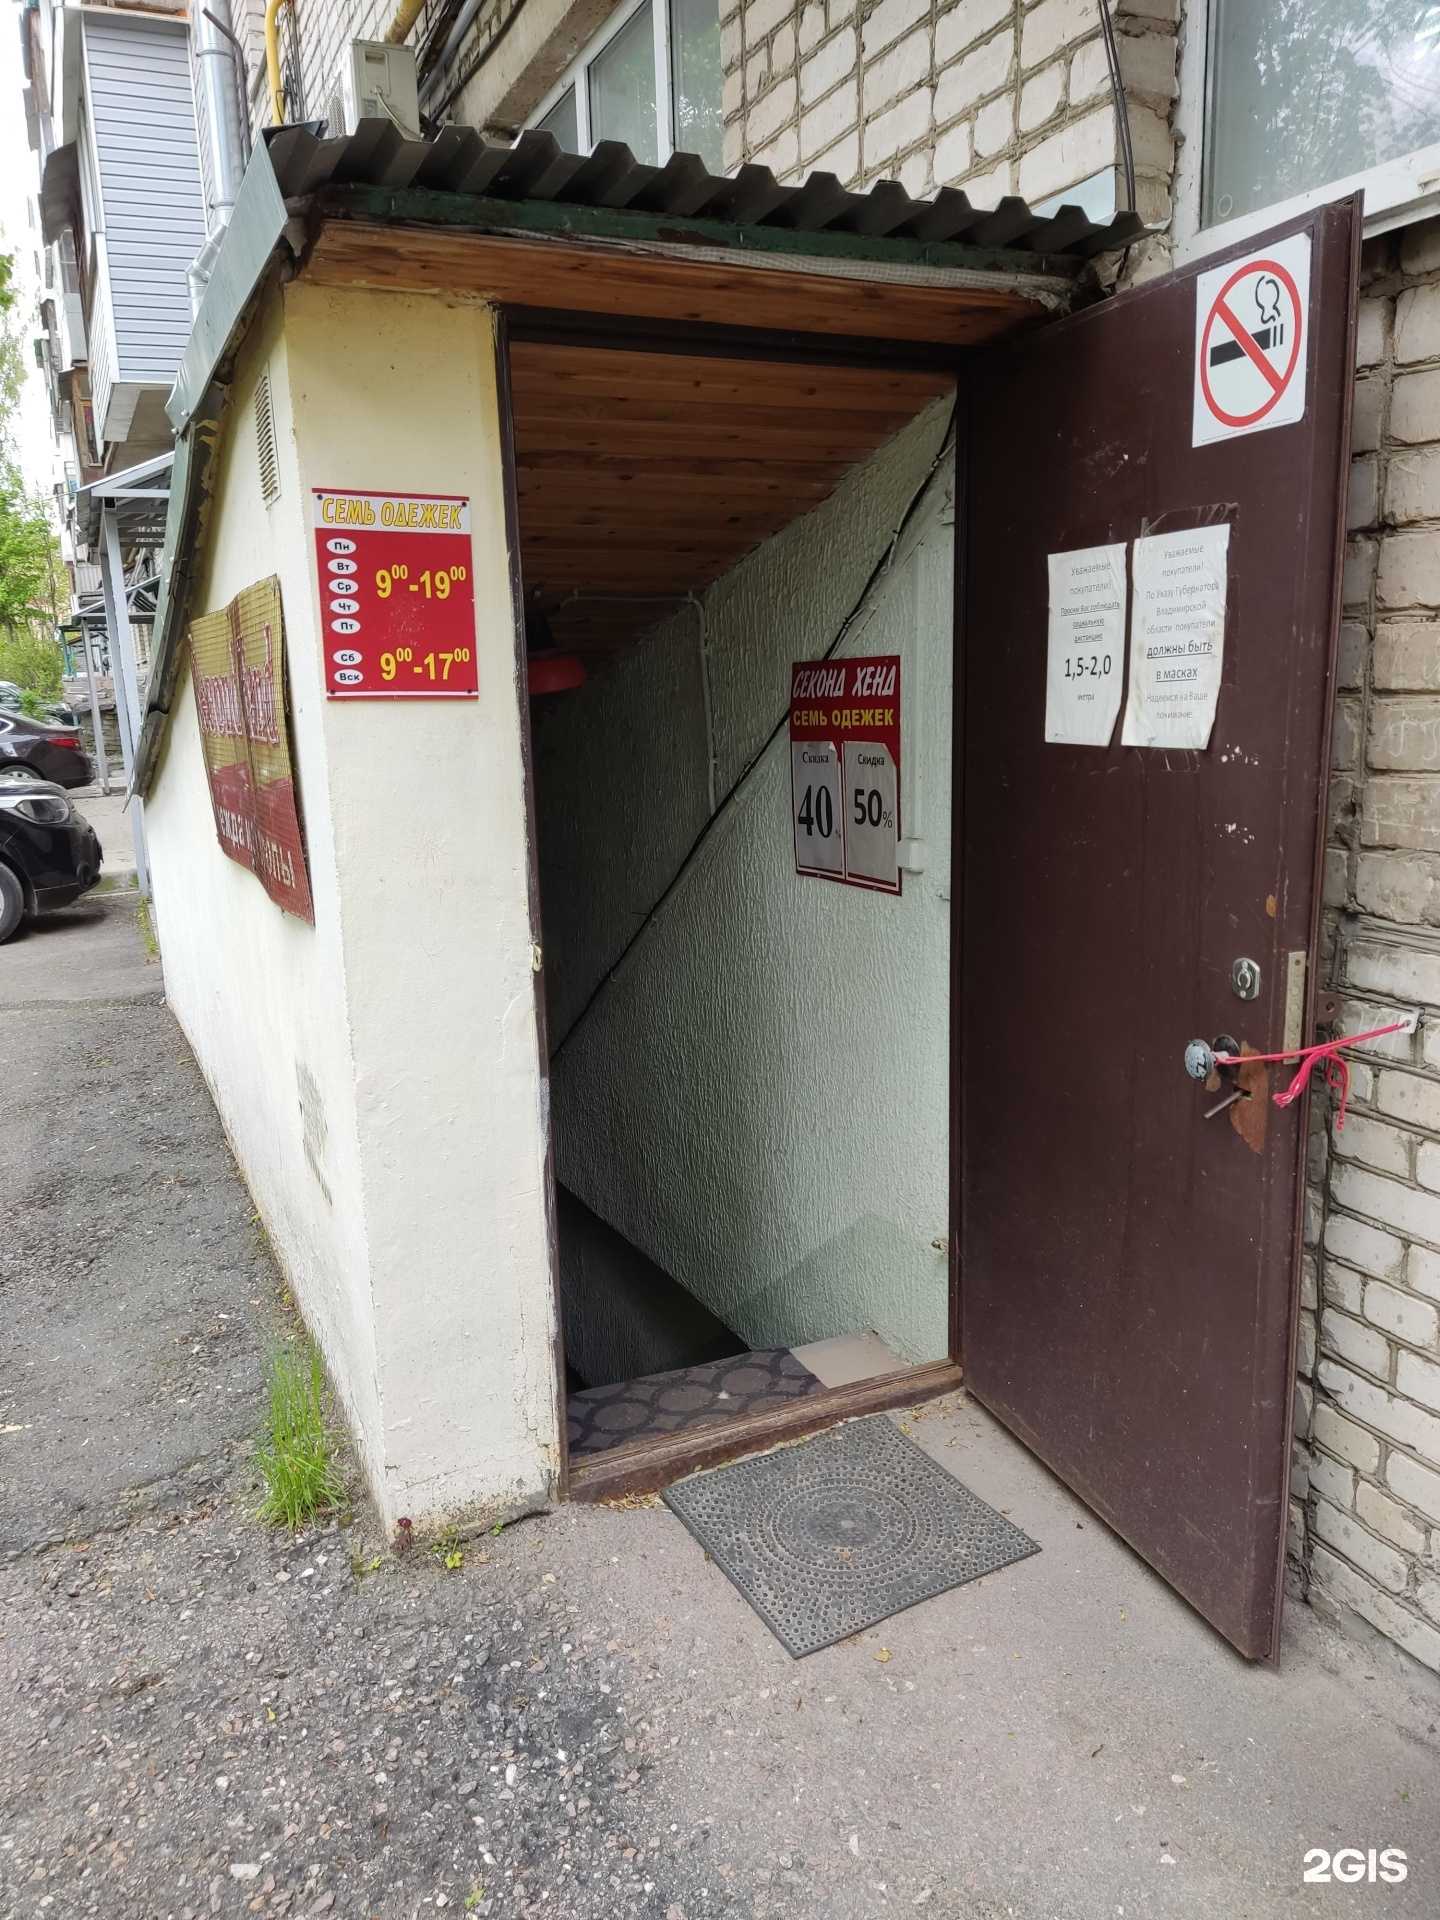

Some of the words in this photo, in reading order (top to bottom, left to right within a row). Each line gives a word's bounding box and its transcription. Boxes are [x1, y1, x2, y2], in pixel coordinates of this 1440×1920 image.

[322, 497, 376, 526] СЕМЬ
[381, 501, 462, 529] ОДЕЖЕК
[334, 541, 350, 551] Пн
[337, 562, 350, 572] Вт
[337, 582, 352, 594] Ср
[338, 602, 351, 611] Чт
[340, 622, 354, 631] Пт
[1147, 645, 1186, 659] должны
[1187, 640, 1213, 653] быть
[340, 653, 355, 663] Сб
[1065, 654, 1112, 680] 1,5-2,0
[339, 672, 360, 682] Вск
[1163, 667, 1199, 680] масках
[793, 668, 846, 699] СЕКОНД
[851, 665, 897, 697] ХЕНД
[793, 709, 828, 726] СЕМЬ
[831, 708, 895, 729] ОДЕЖЕК
[857, 753, 885, 767] Скидка
